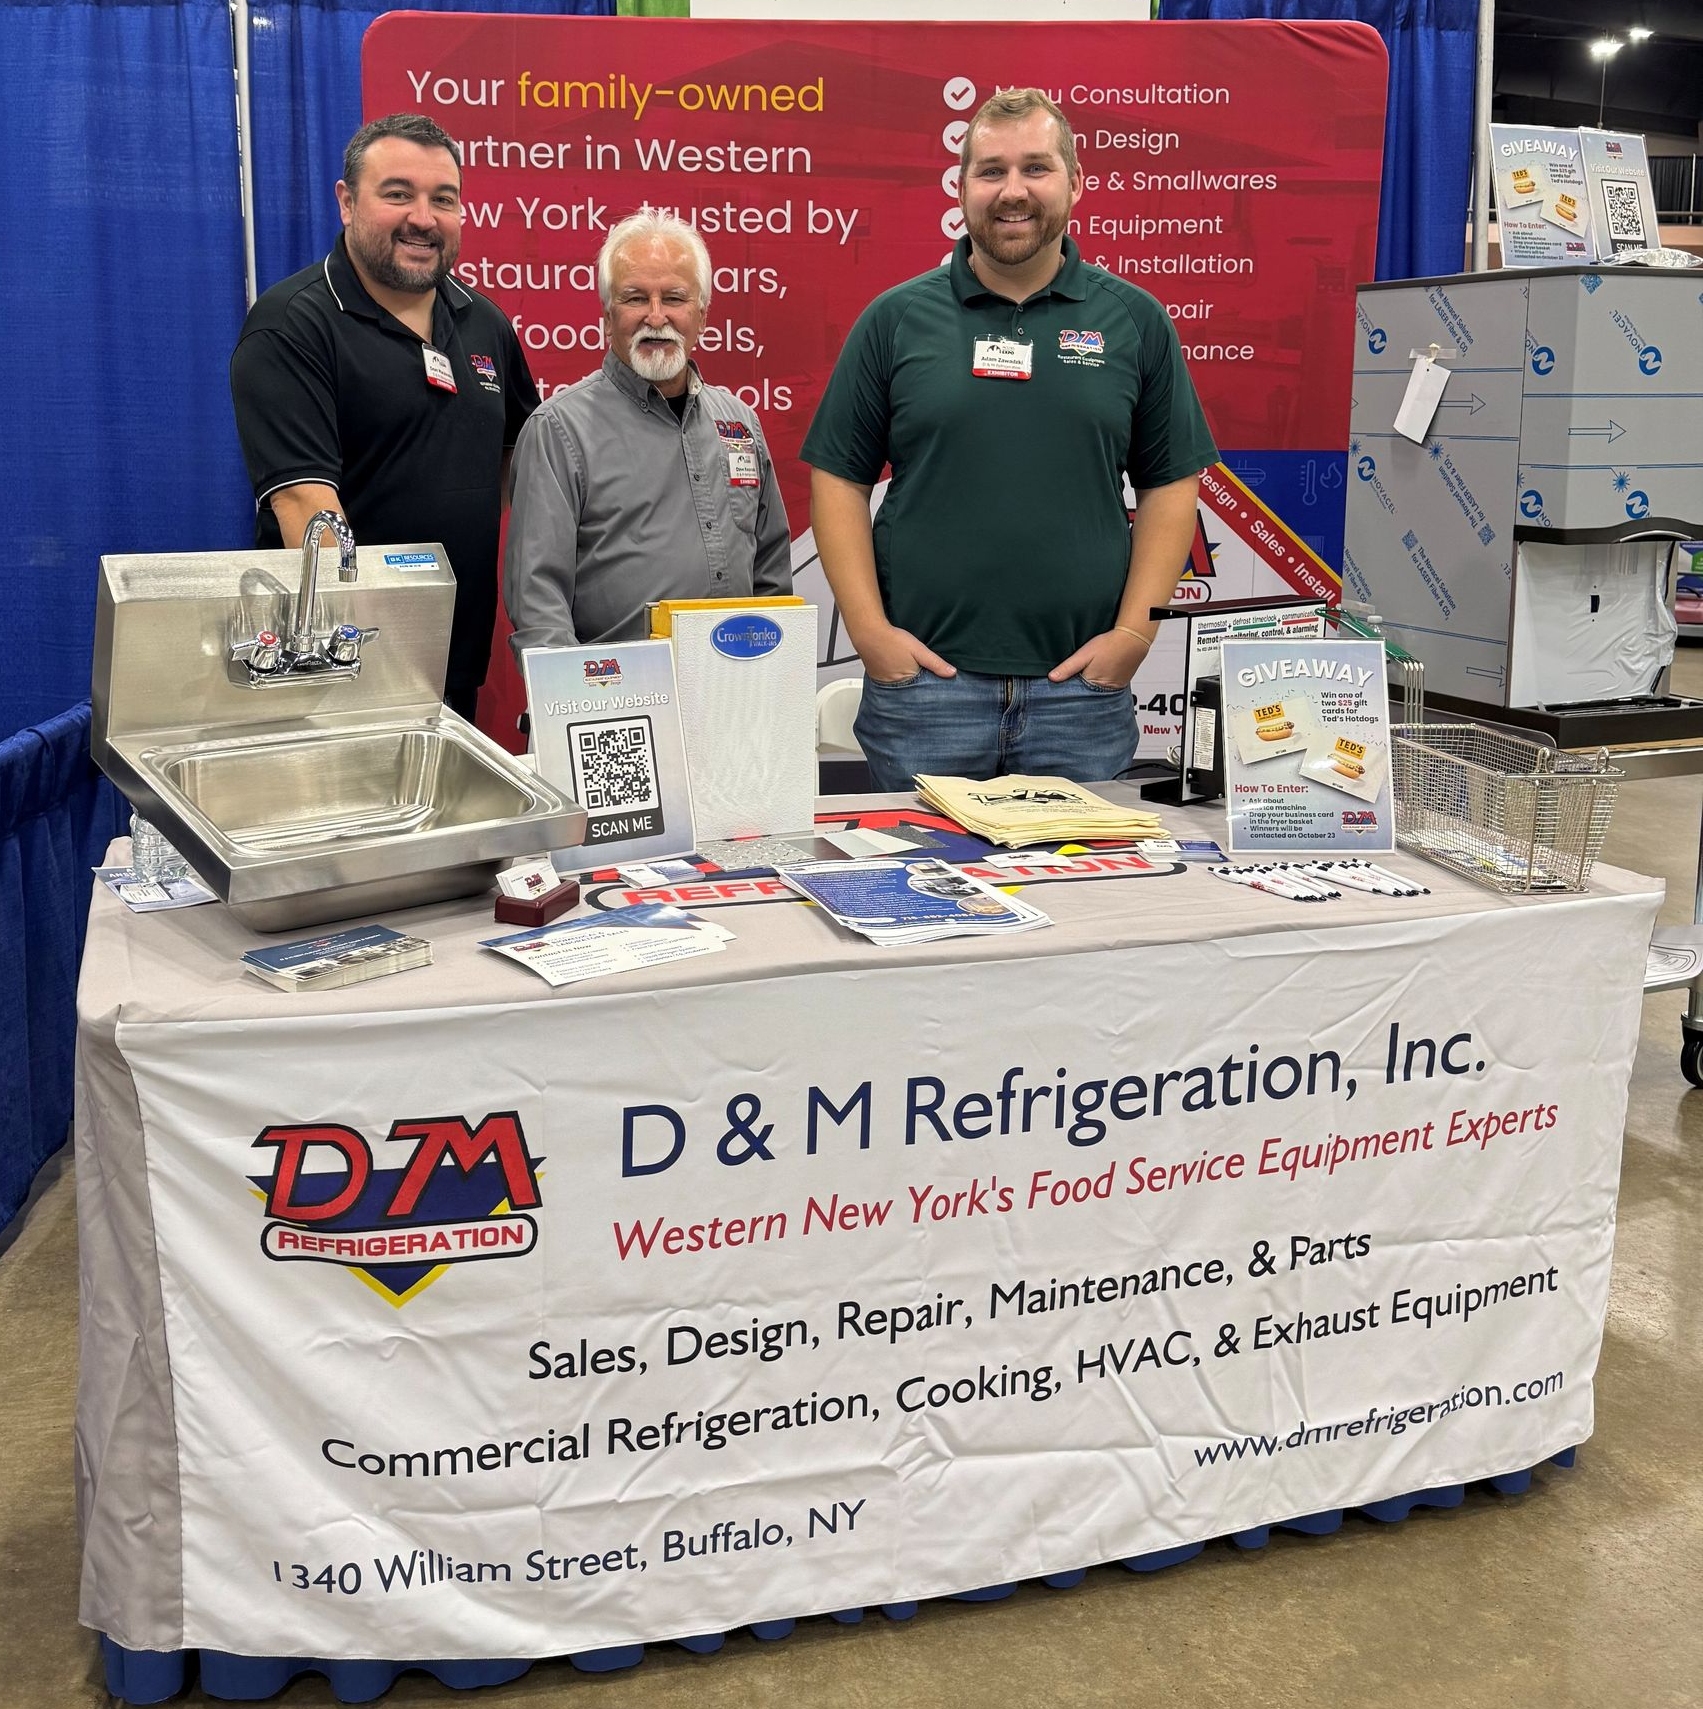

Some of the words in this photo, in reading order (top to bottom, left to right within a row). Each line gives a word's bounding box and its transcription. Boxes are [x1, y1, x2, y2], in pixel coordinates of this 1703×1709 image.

[407, 70, 504, 106] Your
[518, 71, 824, 120] family-owned
[1070, 83, 1230, 105] Consultation
[453, 135, 571, 170] artner
[585, 134, 621, 170] in
[635, 138, 812, 174] Western
[1095, 128, 1180, 155] Design
[1501, 139, 1578, 161] GIVEAWAY
[1107, 172, 1125, 190] &
[1132, 170, 1278, 190] Smallwares
[639, 200, 792, 234] usted
[808, 200, 858, 245] by
[1089, 214, 1223, 241] Equipment
[1118, 254, 1254, 274] Installation
[713, 266, 787, 300] ars,
[1250, 519, 1286, 557] Sales
[1294, 562, 1336, 602] Install
[1198, 620, 1228, 630] thermostat
[1232, 616, 1252, 626] defrost
[1252, 614, 1277, 624] timeclock
[1282, 610, 1316, 620] communicatio
[1197, 636, 1224, 646] Remot
[1262, 628, 1285, 638] control,
[1292, 624, 1318, 634] alarming
[1238, 658, 1374, 688] GIVEAWAY
[544, 699, 578, 716] Visit
[581, 699, 608, 712] Our
[610, 691, 670, 710] Website
[1256, 704, 1282, 718] TED'S
[1322, 707, 1346, 715] cards
[1338, 699, 1353, 708] $25
[1354, 699, 1368, 708] gift
[1345, 715, 1379, 724] Hotdogs
[1338, 738, 1364, 755] TED'S
[1235, 784, 1260, 794] How
[1261, 784, 1275, 794] To
[1277, 784, 1309, 794] Enter:
[591, 822, 629, 838] SCAN
[632, 816, 653, 832] ME
[1266, 812, 1284, 820] your
[1270, 818, 1287, 826] fryer
[621, 1103, 686, 1178] D
[715, 1092, 776, 1167] &
[807, 1080, 871, 1156] M
[904, 1044, 1358, 1146] Refrigeration,
[1386, 1022, 1485, 1084] Inc.
[613, 1209, 786, 1262] Western
[802, 1193, 892, 1248] New
[907, 1178, 1013, 1226] York's
[1028, 1161, 1116, 1210] Food
[1126, 1149, 1244, 1196] Service
[1258, 1121, 1434, 1178] Equipment
[1446, 1102, 1558, 1152] Experts
[276, 1224, 526, 1258] REFRIGERATION
[528, 1339, 648, 1380] Sales,
[666, 1318, 820, 1369] Design,
[837, 1294, 973, 1345] Repair,
[990, 1256, 1235, 1320] Maintenance,
[1248, 1238, 1277, 1278] &
[1290, 1230, 1372, 1270] Parts
[321, 1422, 590, 1478] Commercial
[607, 1392, 881, 1456] Refrigeration,
[896, 1364, 1062, 1414] Cooking,
[1076, 1330, 1201, 1384] HVAC,
[1213, 1322, 1242, 1356] &
[1252, 1301, 1380, 1350] Exhaust
[1392, 1264, 1558, 1324] Equipment
[1194, 1369, 1565, 1468] www.dmrefrigeration.com
[272, 1559, 362, 1596] 1340
[374, 1550, 512, 1592] William
[526, 1542, 648, 1583] Street,
[662, 1517, 794, 1563] Buffalo,
[807, 1498, 866, 1538] NY
